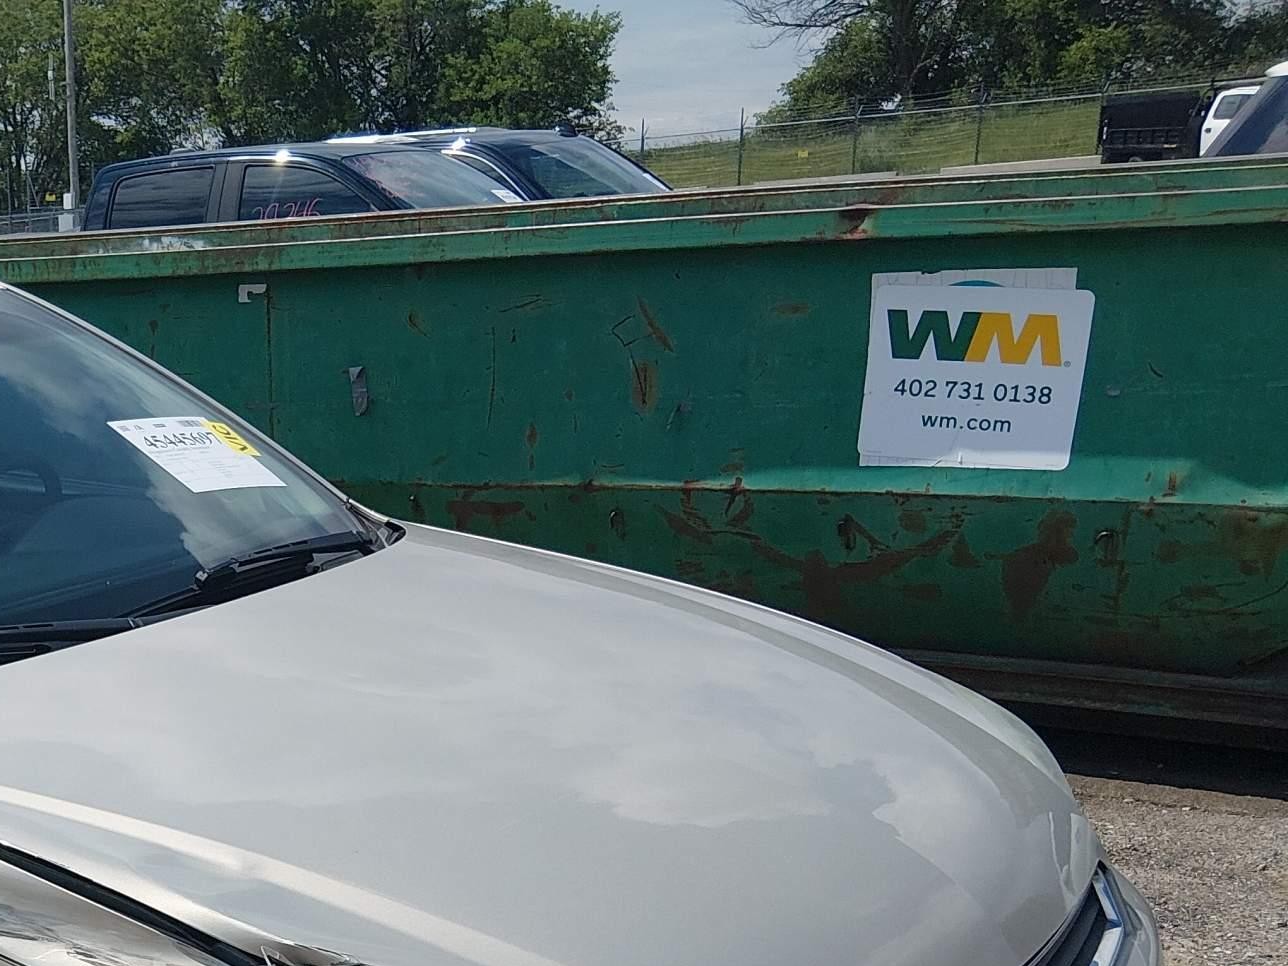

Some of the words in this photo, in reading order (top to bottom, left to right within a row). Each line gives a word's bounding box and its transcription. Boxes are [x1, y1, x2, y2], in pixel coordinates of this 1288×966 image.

[887, 309, 1062, 367] WM
[894, 378, 937, 398] 402
[945, 380, 985, 401] 731
[993, 383, 1053, 405] 0138
[921, 414, 1012, 433] wm.com
[143, 431, 222, 449] 45445697
